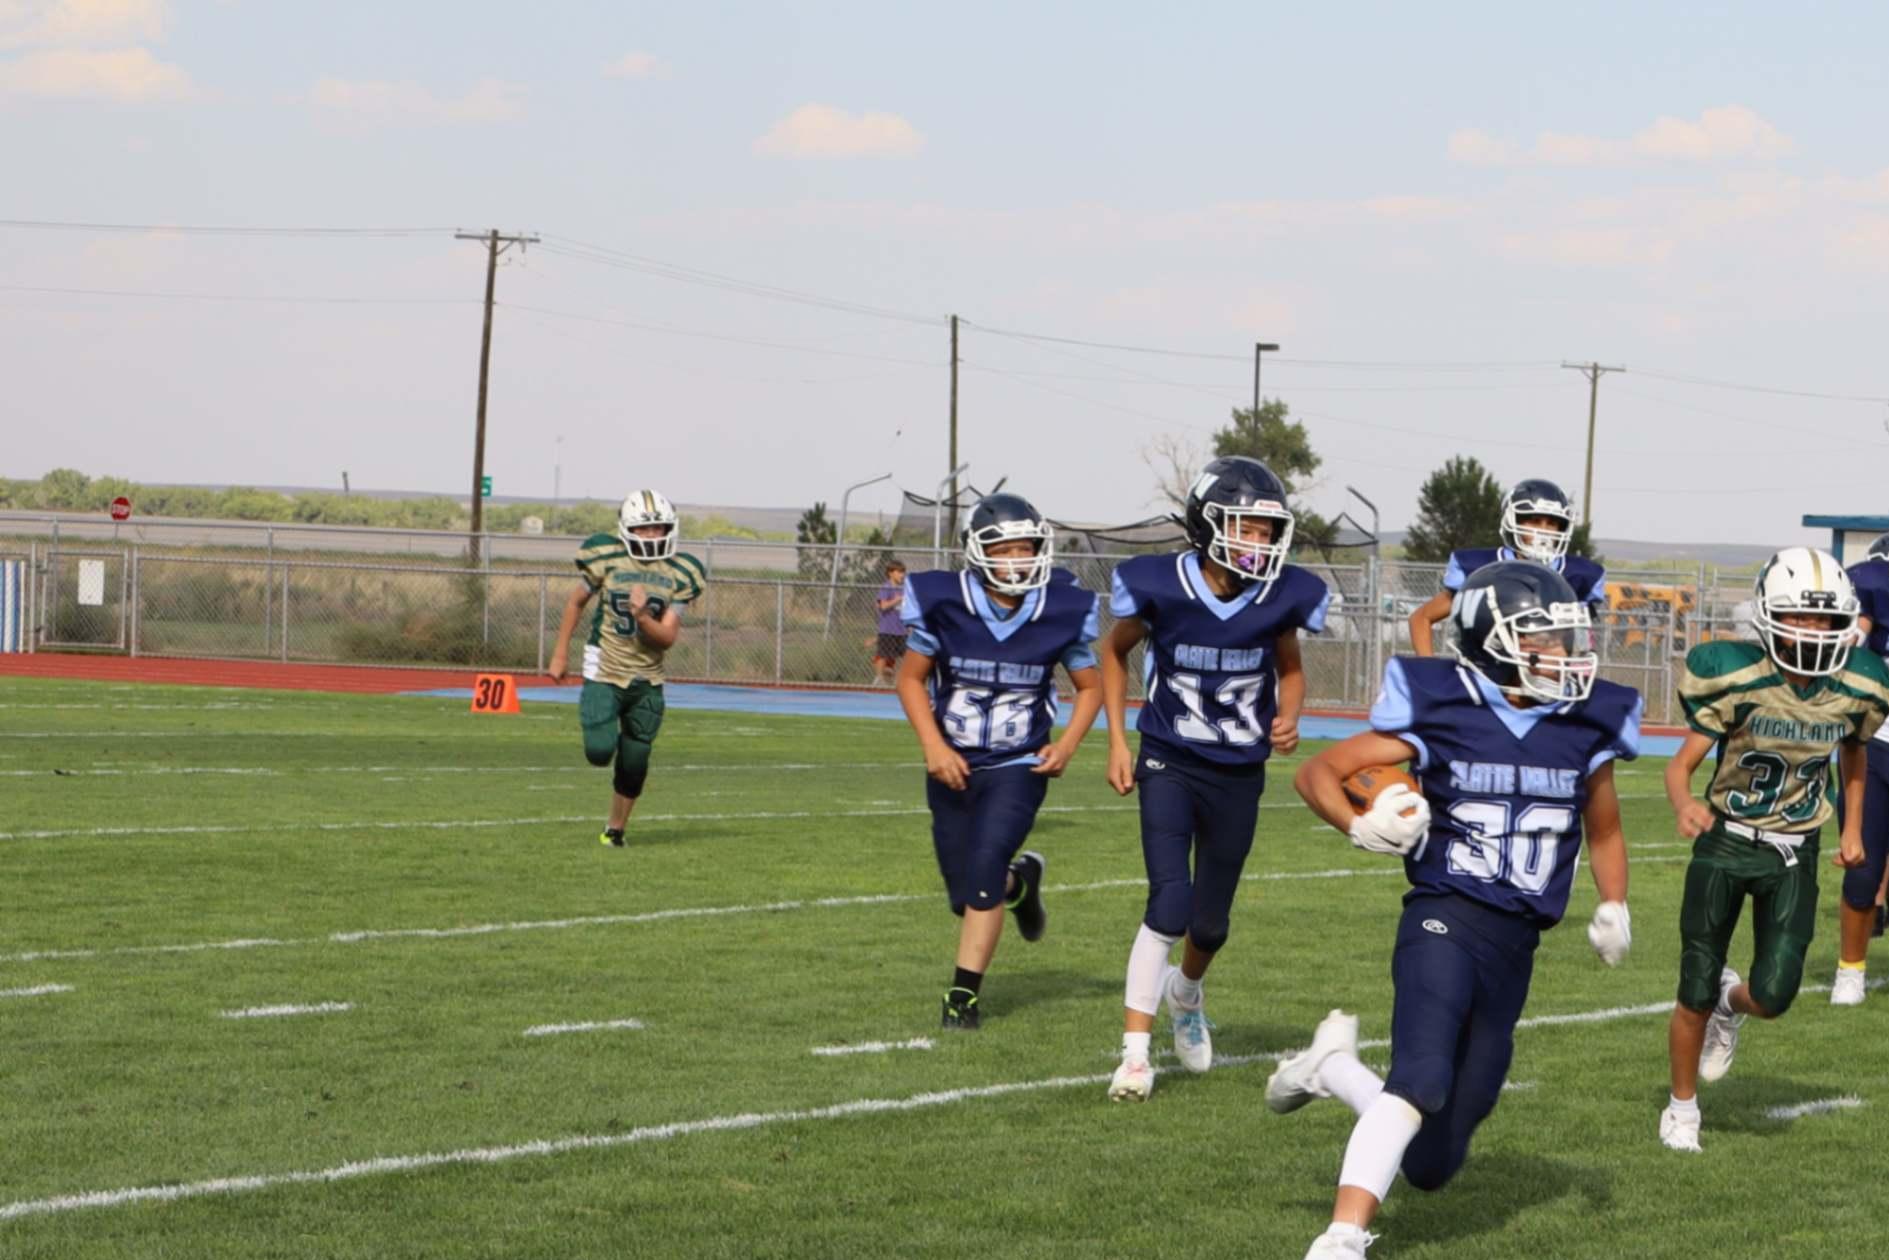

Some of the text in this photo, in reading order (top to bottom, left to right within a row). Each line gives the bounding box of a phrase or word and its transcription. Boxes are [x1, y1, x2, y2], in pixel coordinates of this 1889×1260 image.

[475, 678, 505, 710] 30
[944, 684, 1038, 750] 56
[1167, 672, 1265, 746] 13
[1449, 760, 1580, 799] PLATTE VALLEY
[1726, 750, 1829, 823] 33
[1446, 799, 1575, 895] 30
